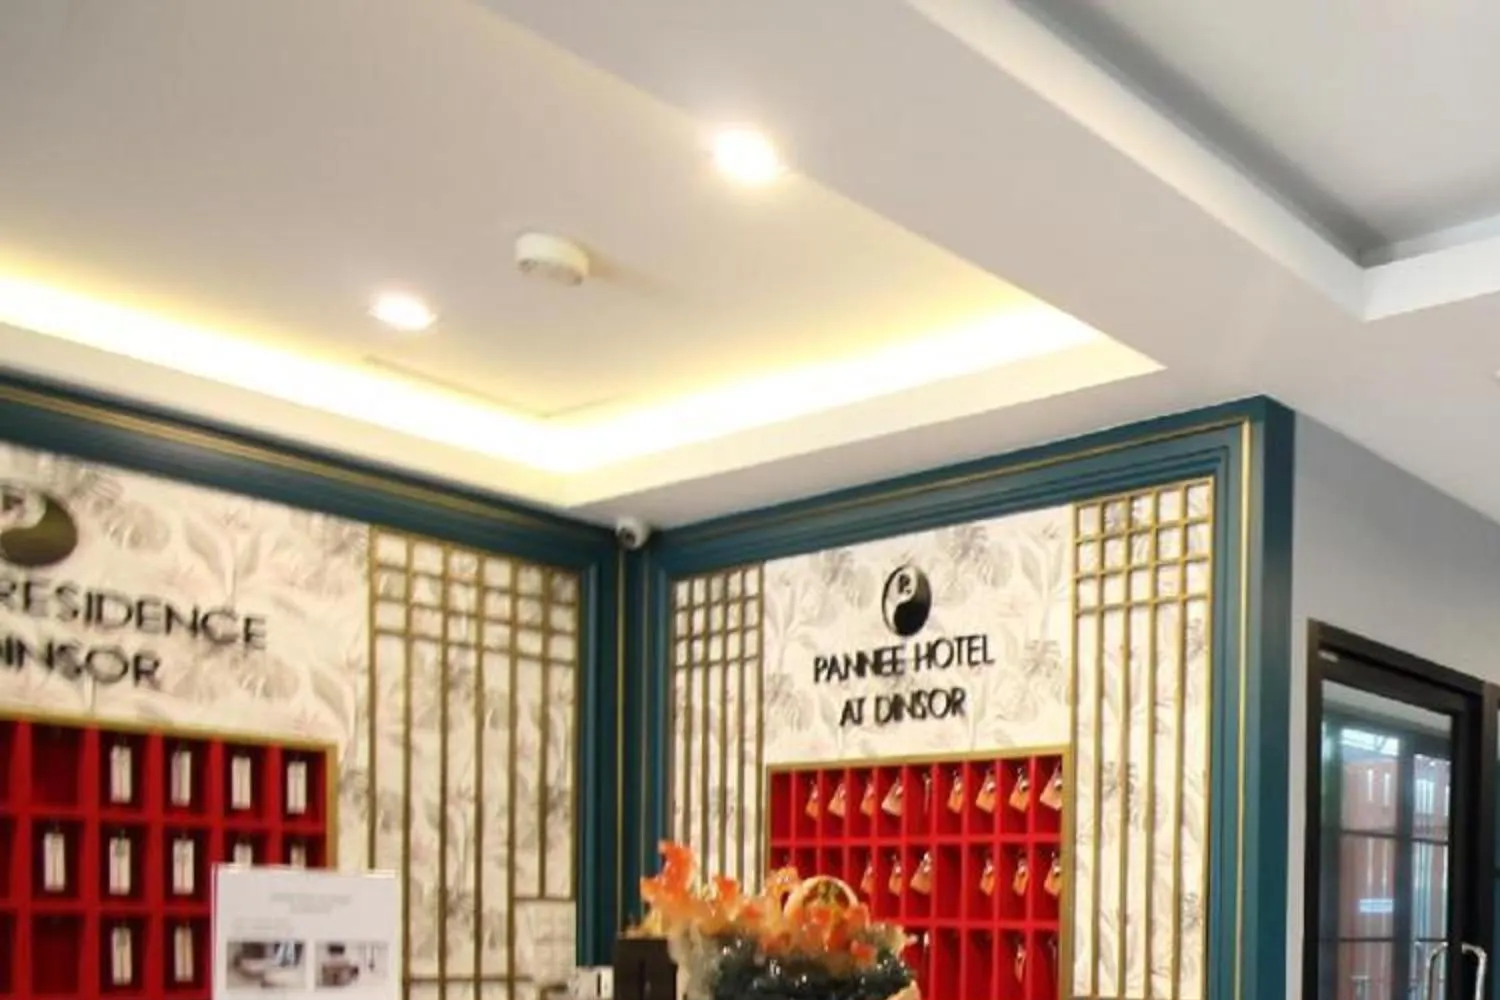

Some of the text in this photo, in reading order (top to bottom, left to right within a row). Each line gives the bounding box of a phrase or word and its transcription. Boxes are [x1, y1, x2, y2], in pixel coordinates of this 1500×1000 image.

[0, 634, 163, 690] INSOR
[813, 635, 995, 684] PANNEE HOTEL
[840, 687, 967, 727] AT DINSOR
